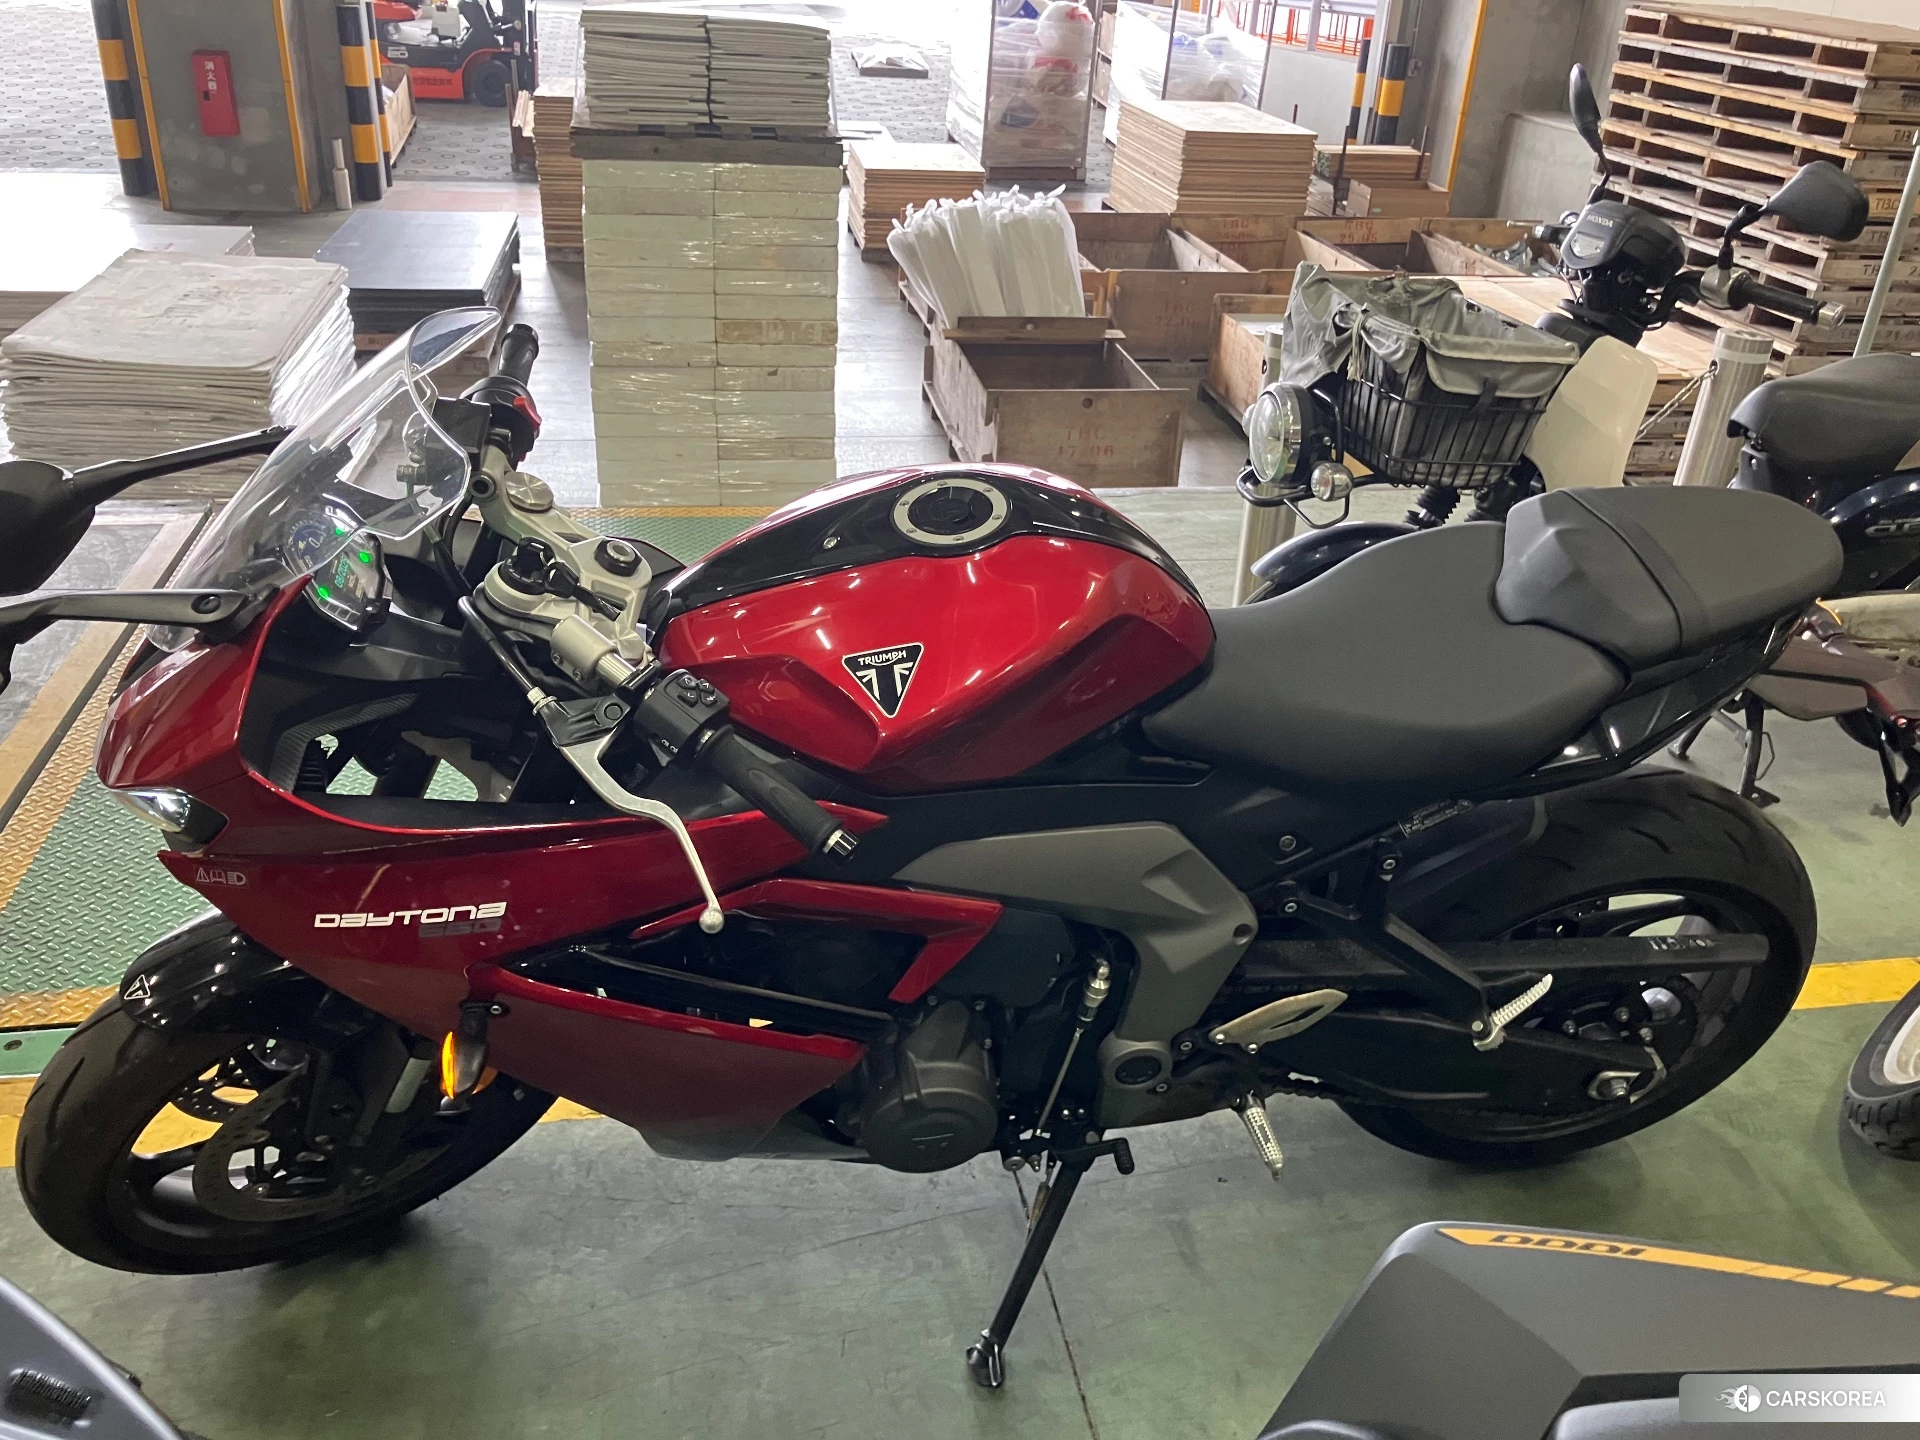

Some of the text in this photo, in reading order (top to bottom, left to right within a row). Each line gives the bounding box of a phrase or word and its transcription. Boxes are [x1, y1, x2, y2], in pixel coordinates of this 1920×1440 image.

[1586, 214, 1614, 228] HONDA
[857, 650, 907, 666] TRIUMPH
[313, 901, 507, 928] DAYTONA
